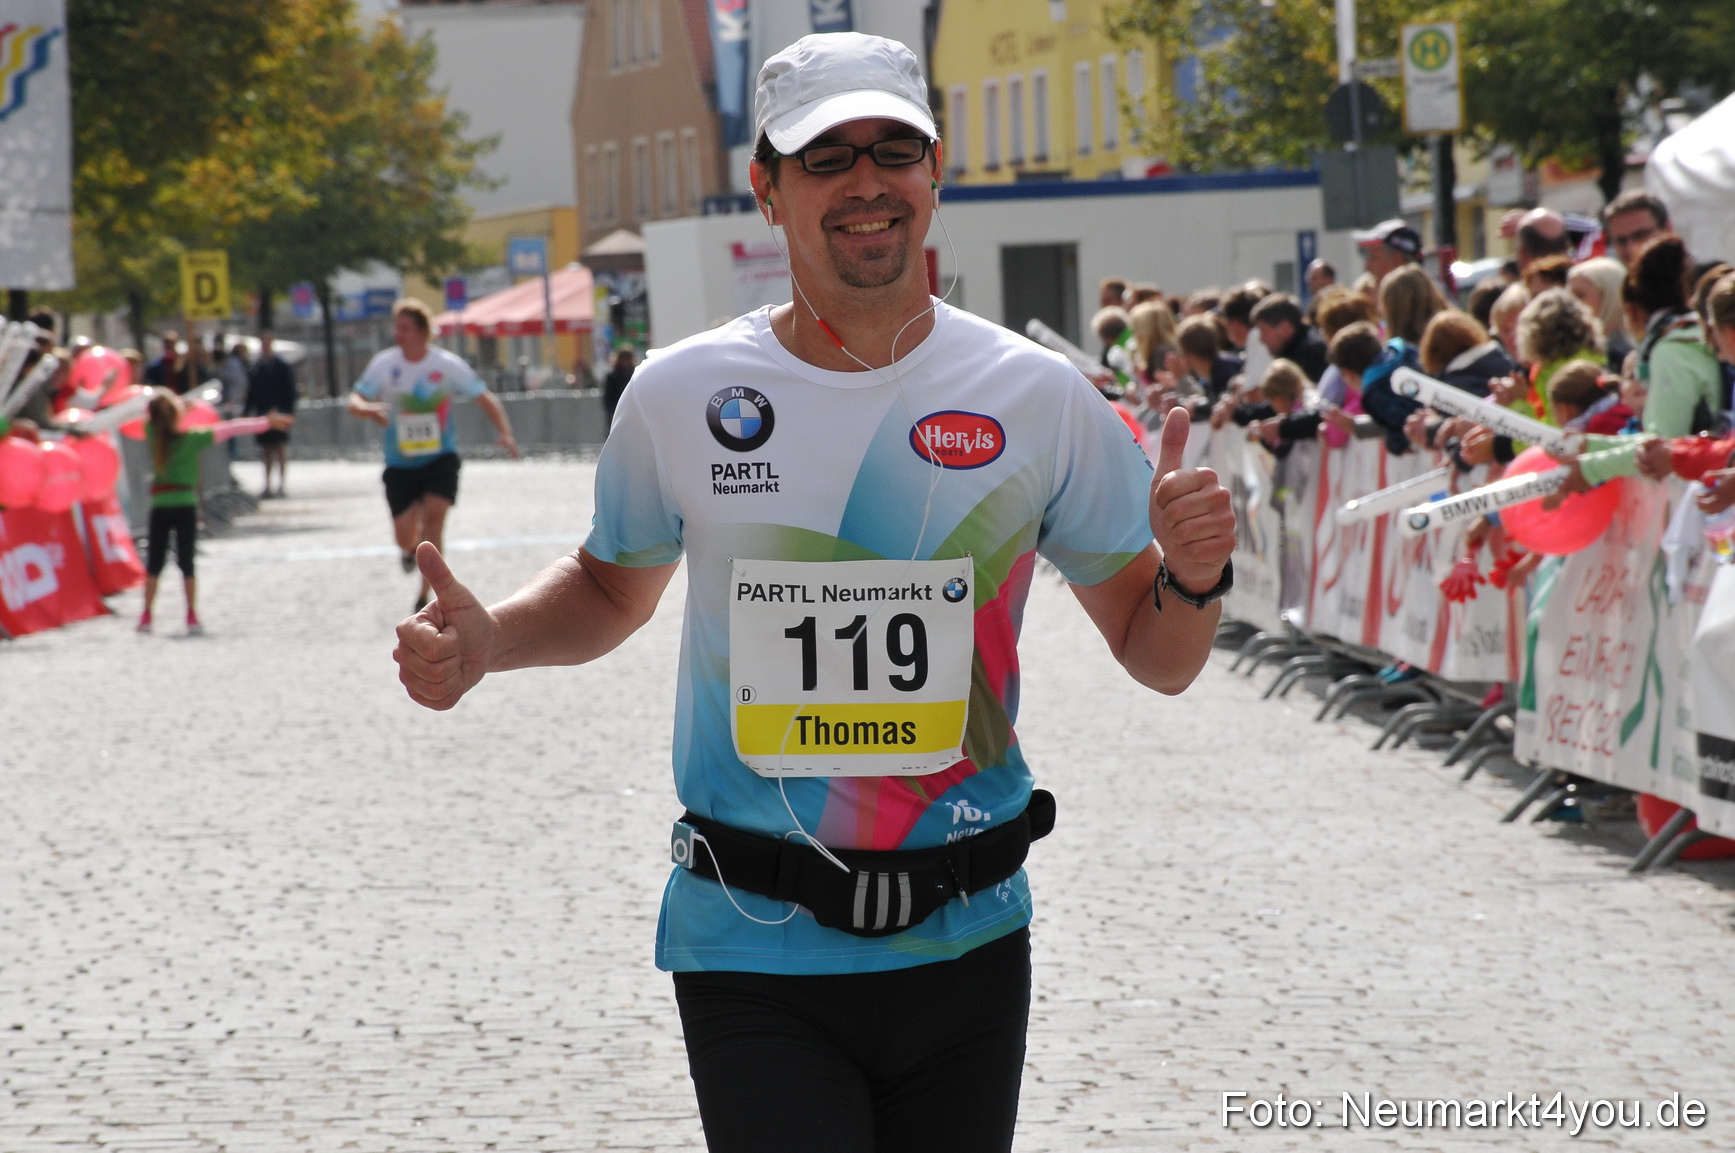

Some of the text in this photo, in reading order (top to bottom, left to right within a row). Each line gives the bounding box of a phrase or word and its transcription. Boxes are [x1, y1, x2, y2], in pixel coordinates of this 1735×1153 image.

[193, 272, 218, 305] D
[710, 387, 768, 409] BMW
[925, 425, 995, 454] Hervis
[930, 449, 964, 457] PORTS
[711, 462, 780, 482] PARTL
[713, 480, 780, 495] Neumarkt
[1441, 475, 1564, 521] BMW Laufspo
[737, 582, 933, 604] PARTL Neumarkt
[784, 612, 929, 692] 119
[741, 688, 751, 702] D
[794, 715, 917, 746] Thomas
[945, 799, 991, 825] 16.
